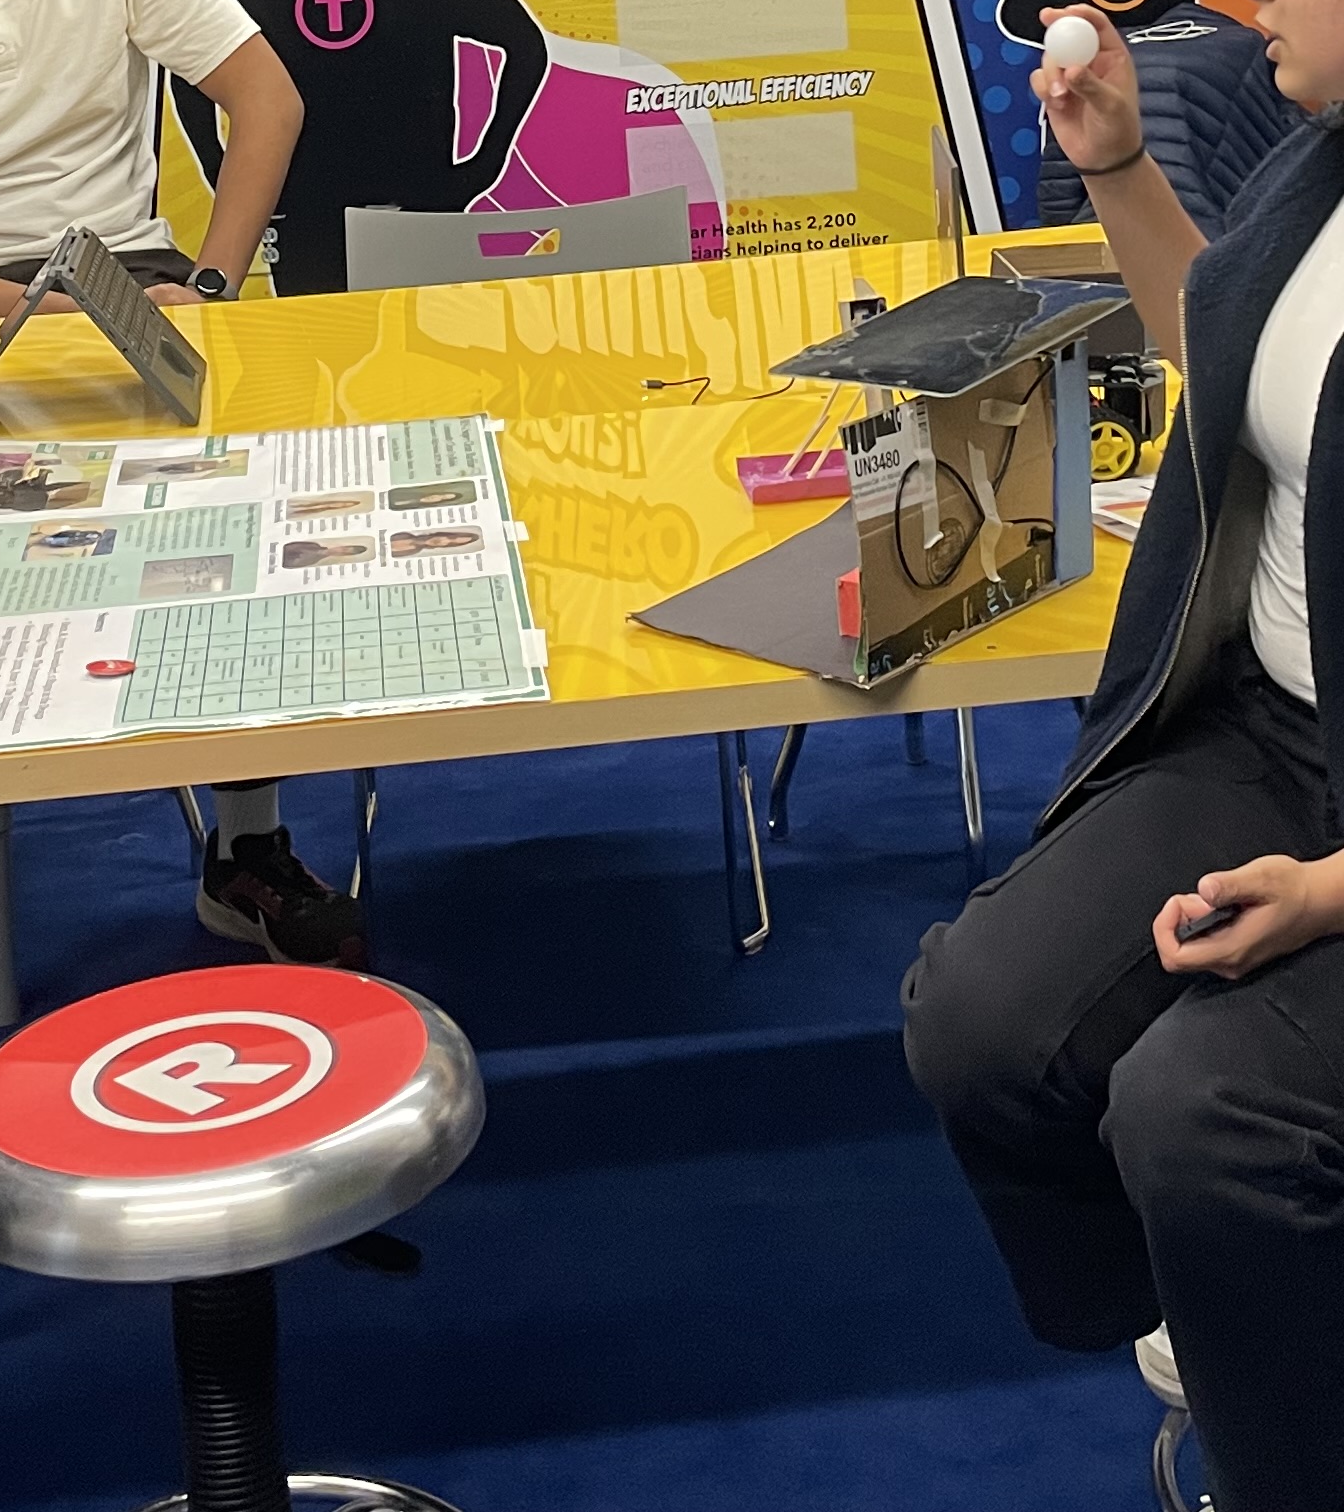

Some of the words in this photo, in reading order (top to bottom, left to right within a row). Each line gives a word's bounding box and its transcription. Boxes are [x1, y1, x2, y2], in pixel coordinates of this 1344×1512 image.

[625, 78, 756, 114] EXCEPTIONAL
[759, 70, 874, 104] EFFICIENCY
[712, 220, 768, 237] Health
[773, 216, 801, 232] has
[806, 213, 856, 230] 2,200
[807, 238, 824, 250] to
[829, 233, 889, 250] deliver
[854, 448, 900, 477] UN3480
[114, 1042, 295, 1116] R
